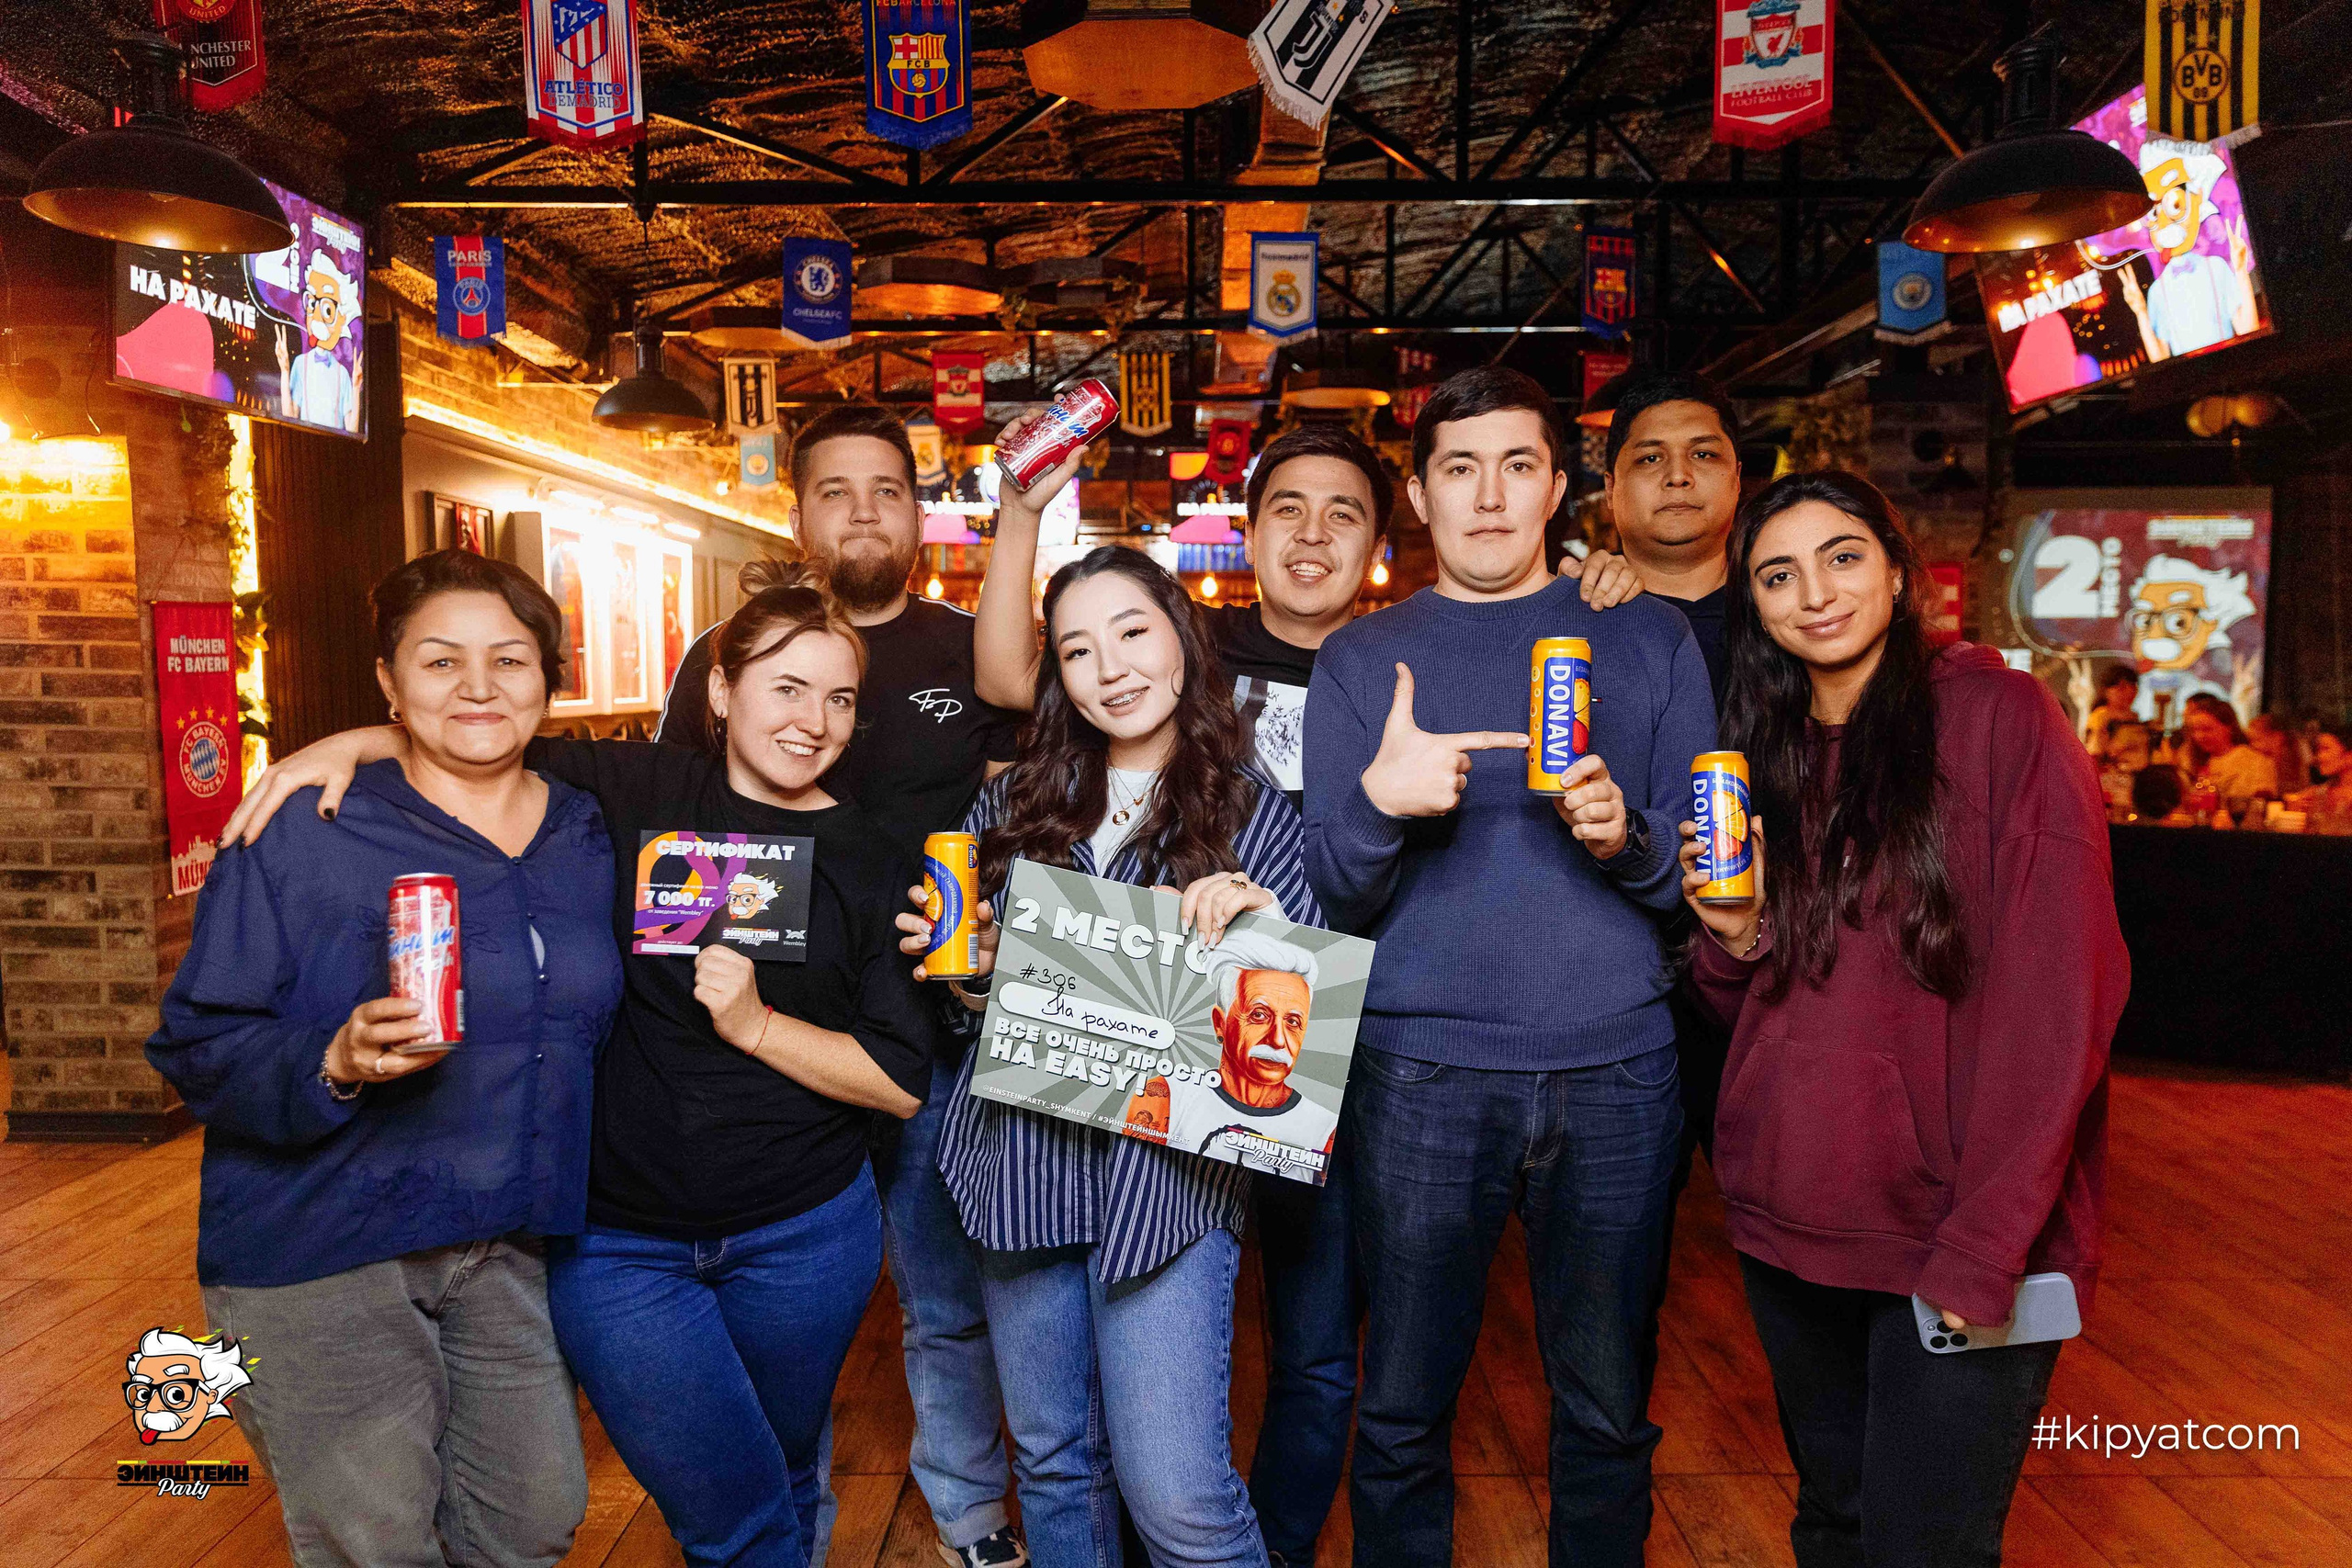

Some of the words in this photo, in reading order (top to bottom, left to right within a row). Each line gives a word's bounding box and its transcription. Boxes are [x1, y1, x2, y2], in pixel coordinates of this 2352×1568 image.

[189, 6, 226, 18] UNITED
[179, 40, 251, 54] NCHESTER
[2182, 53, 2222, 87] BVB
[543, 78, 624, 96] ATLÉTICO
[1730, 74, 1814, 98] LIVERPOOL
[1730, 94, 1782, 107] FOOTBALL
[1785, 88, 1814, 100] CLUB
[447, 250, 492, 263] PARIS
[130, 264, 166, 301] НА
[168, 277, 256, 331] РАХАТЕ
[2030, 535, 2101, 619] 2
[170, 635, 226, 655] MÜNCHEN
[167, 657, 182, 672] FC
[185, 656, 230, 673] BAYERN
[1546, 665, 1571, 766] DONAVI
[1692, 778, 1712, 874] DONAVI
[655, 840, 796, 861] СЕРТИФИКАТ
[644, 890, 656, 905] 7
[658, 890, 695, 907] 000
[1011, 897, 1042, 934] 2
[1080, 1010, 1159, 1040] рахате
[994, 1015, 1042, 1043] ВСЕ
[1045, 1030, 1121, 1064] ОЧЕНЬ
[1125, 1049, 1223, 1089] ПРОСТО
[989, 1035, 1037, 1069] НА
[1045, 1048, 1148, 1097] EASY!
[982, 1084, 1091, 1120] @EINSTEINPARTY_SHYMKENT
[1250, 1148, 1295, 1174] Party
